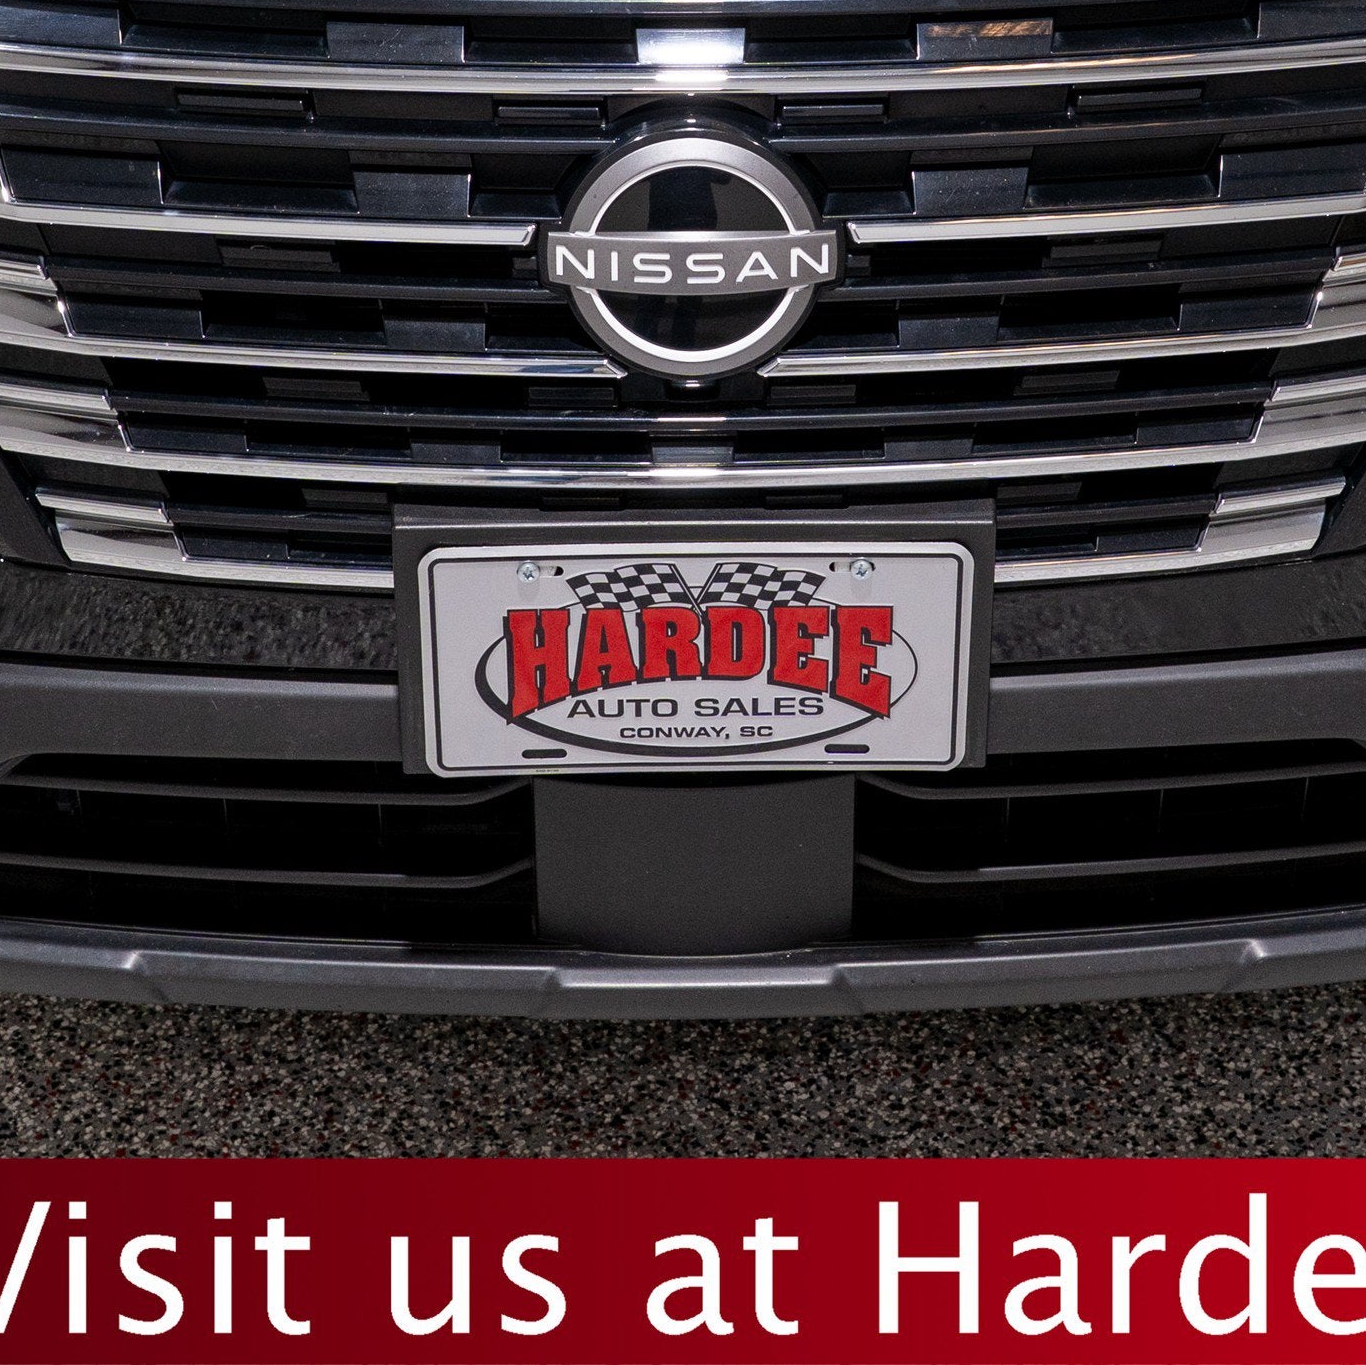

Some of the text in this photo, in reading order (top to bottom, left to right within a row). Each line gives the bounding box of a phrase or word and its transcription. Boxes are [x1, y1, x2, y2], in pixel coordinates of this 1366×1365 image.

[555, 243, 830, 285] NISSAN
[504, 606, 894, 722] HARDEE
[567, 696, 824, 719] AUTO SALES
[618, 725, 774, 740] CONWAY, SC
